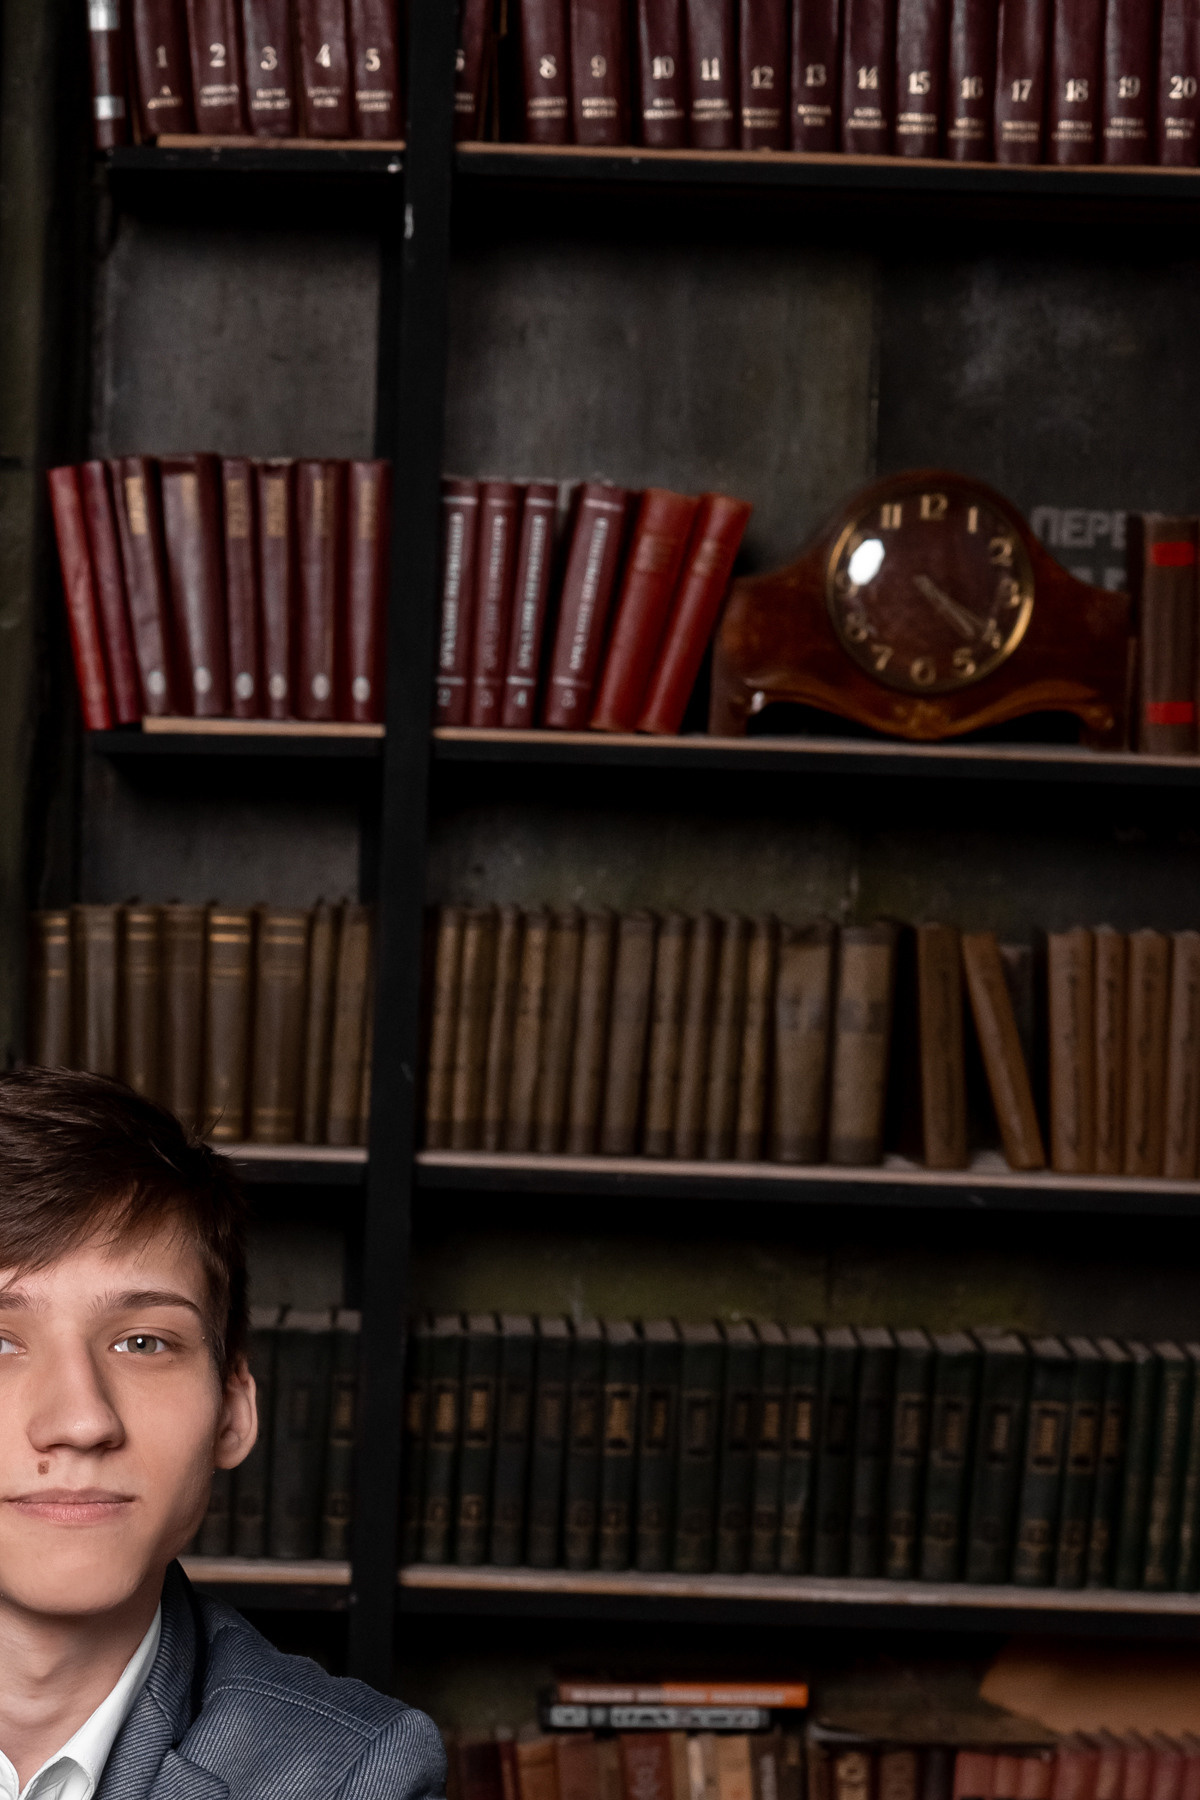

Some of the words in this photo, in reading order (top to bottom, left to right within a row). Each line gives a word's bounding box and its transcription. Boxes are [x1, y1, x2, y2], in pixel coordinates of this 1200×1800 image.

[156, 45, 168, 69] 1
[209, 42, 227, 68] 2
[260, 45, 278, 71] 3
[315, 43, 331, 68] 4
[365, 48, 381, 71] 5
[539, 54, 557, 79] 8
[590, 54, 607, 79] 9
[652, 56, 675, 80] 10
[701, 57, 721, 81] 11
[750, 66, 774, 90] 12
[805, 63, 827, 88] 13
[857, 66, 879, 90] 14
[908, 71, 931, 95] 15
[961, 76, 983, 99] 16
[1011, 79, 1032, 102] 17
[1065, 79, 1088, 102] 18
[1117, 76, 1141, 99] 19
[1169, 76, 1197, 100] 20
[881, 503, 902, 530] 11
[920, 494, 948, 520] 12
[967, 506, 978, 534] 1
[989, 537, 1013, 565] 2
[1000, 578, 1020, 608] 3
[871, 643, 893, 671] 7
[952, 647, 977, 676] 5
[910, 657, 936, 687] 6
